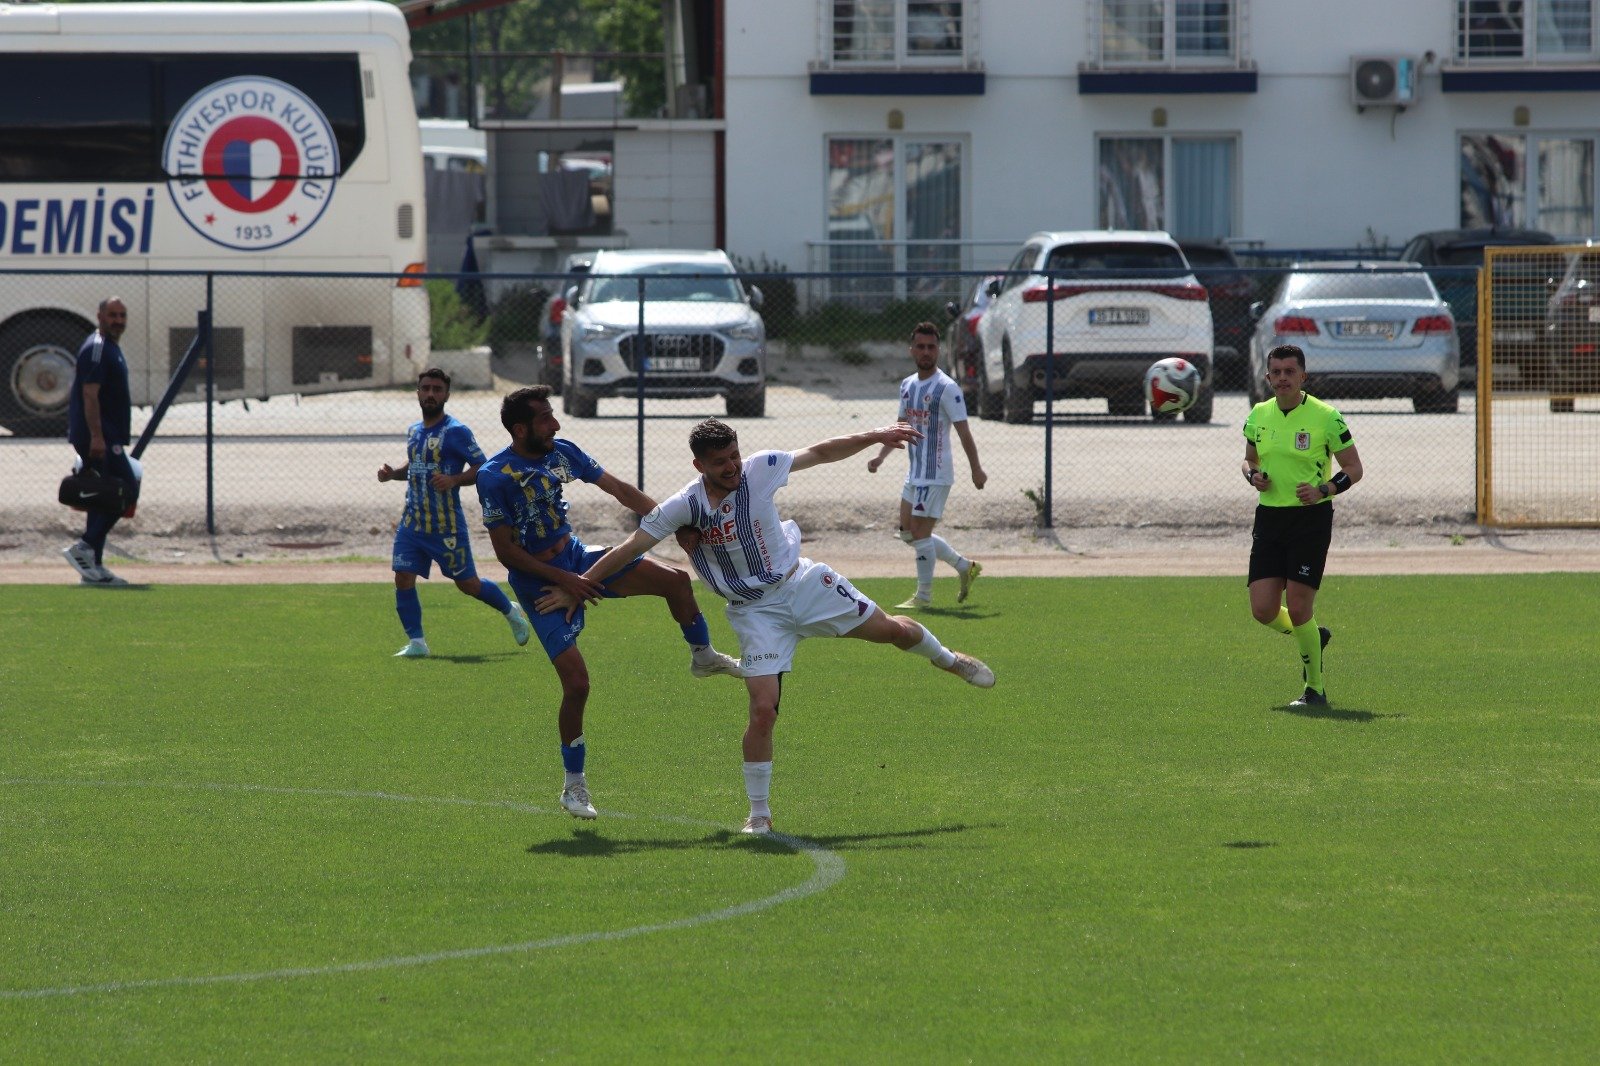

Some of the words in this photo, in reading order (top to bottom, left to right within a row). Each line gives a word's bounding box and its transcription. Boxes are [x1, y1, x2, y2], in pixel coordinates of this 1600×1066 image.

[280, 102, 329, 200] KULÜBÜ
[0, 187, 154, 255] EMİSİ
[236, 225, 273, 240] 1933
[916, 486, 930, 502] 77
[443, 547, 466, 569] 27
[836, 584, 857, 603] 9
